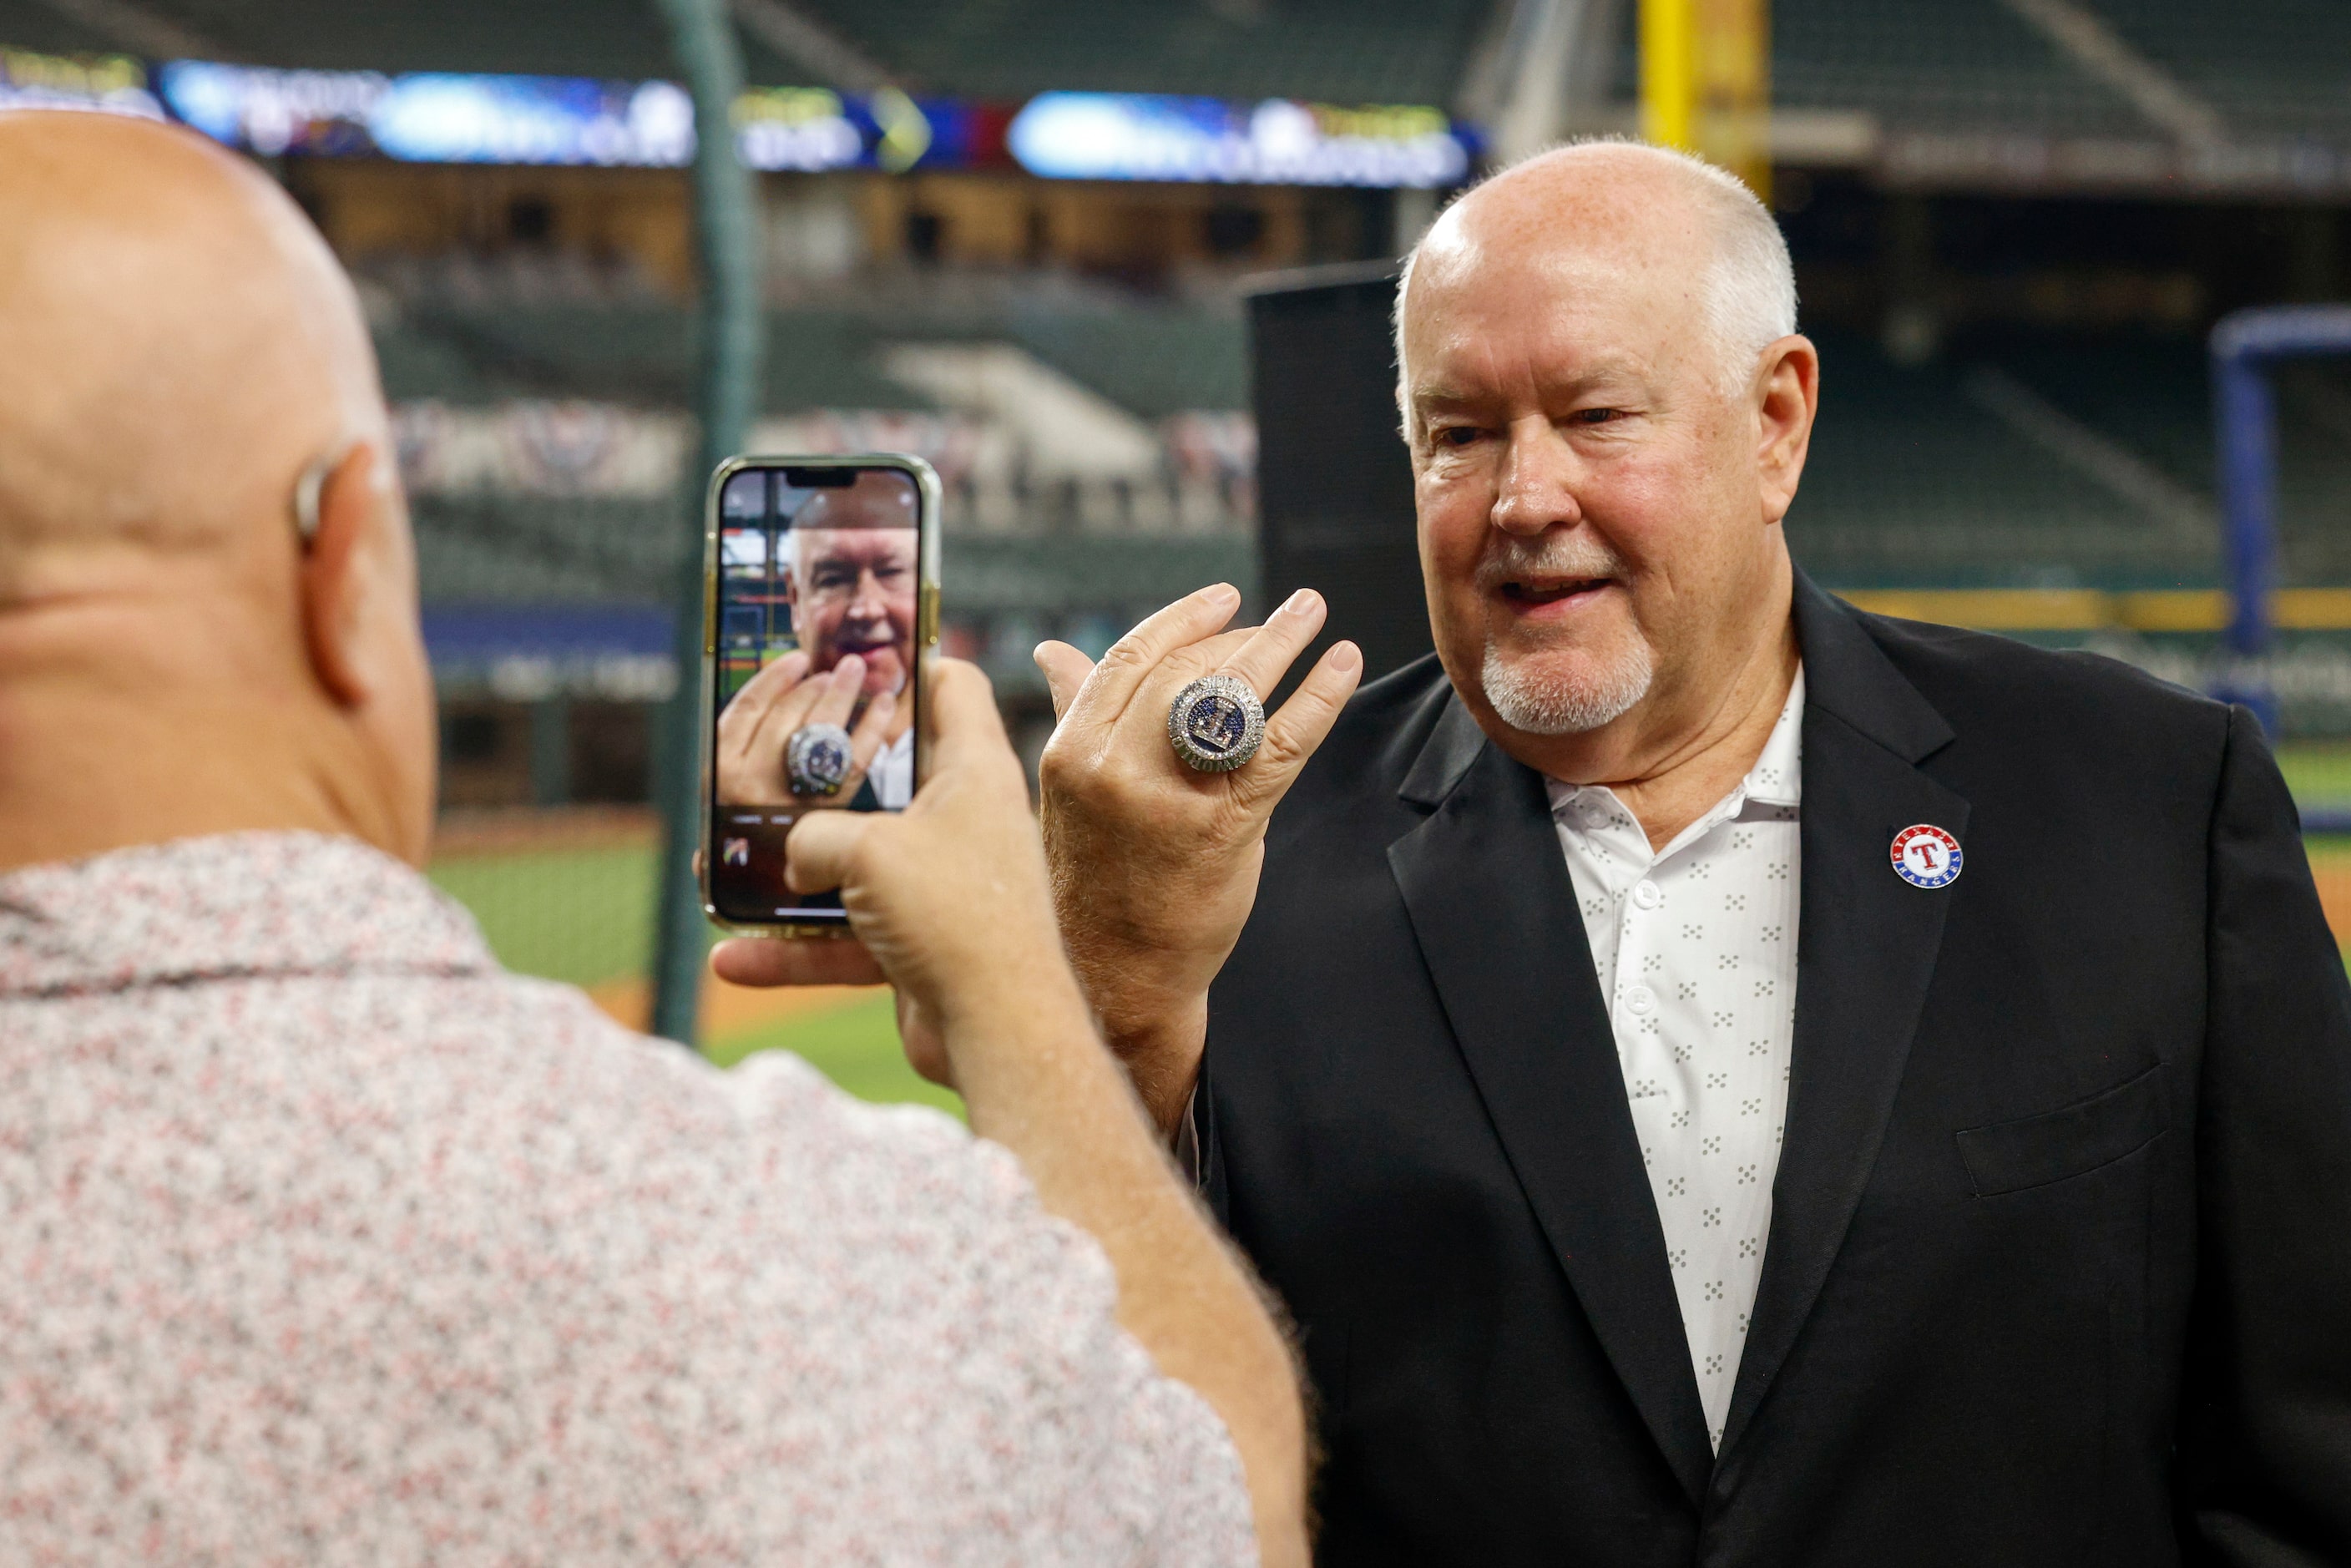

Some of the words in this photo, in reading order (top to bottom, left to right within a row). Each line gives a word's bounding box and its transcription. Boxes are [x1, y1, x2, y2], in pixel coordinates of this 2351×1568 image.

[1894, 827, 1946, 847] TEXAS
[1910, 842, 1938, 870] T
[1898, 855, 1960, 886] RANGERS
